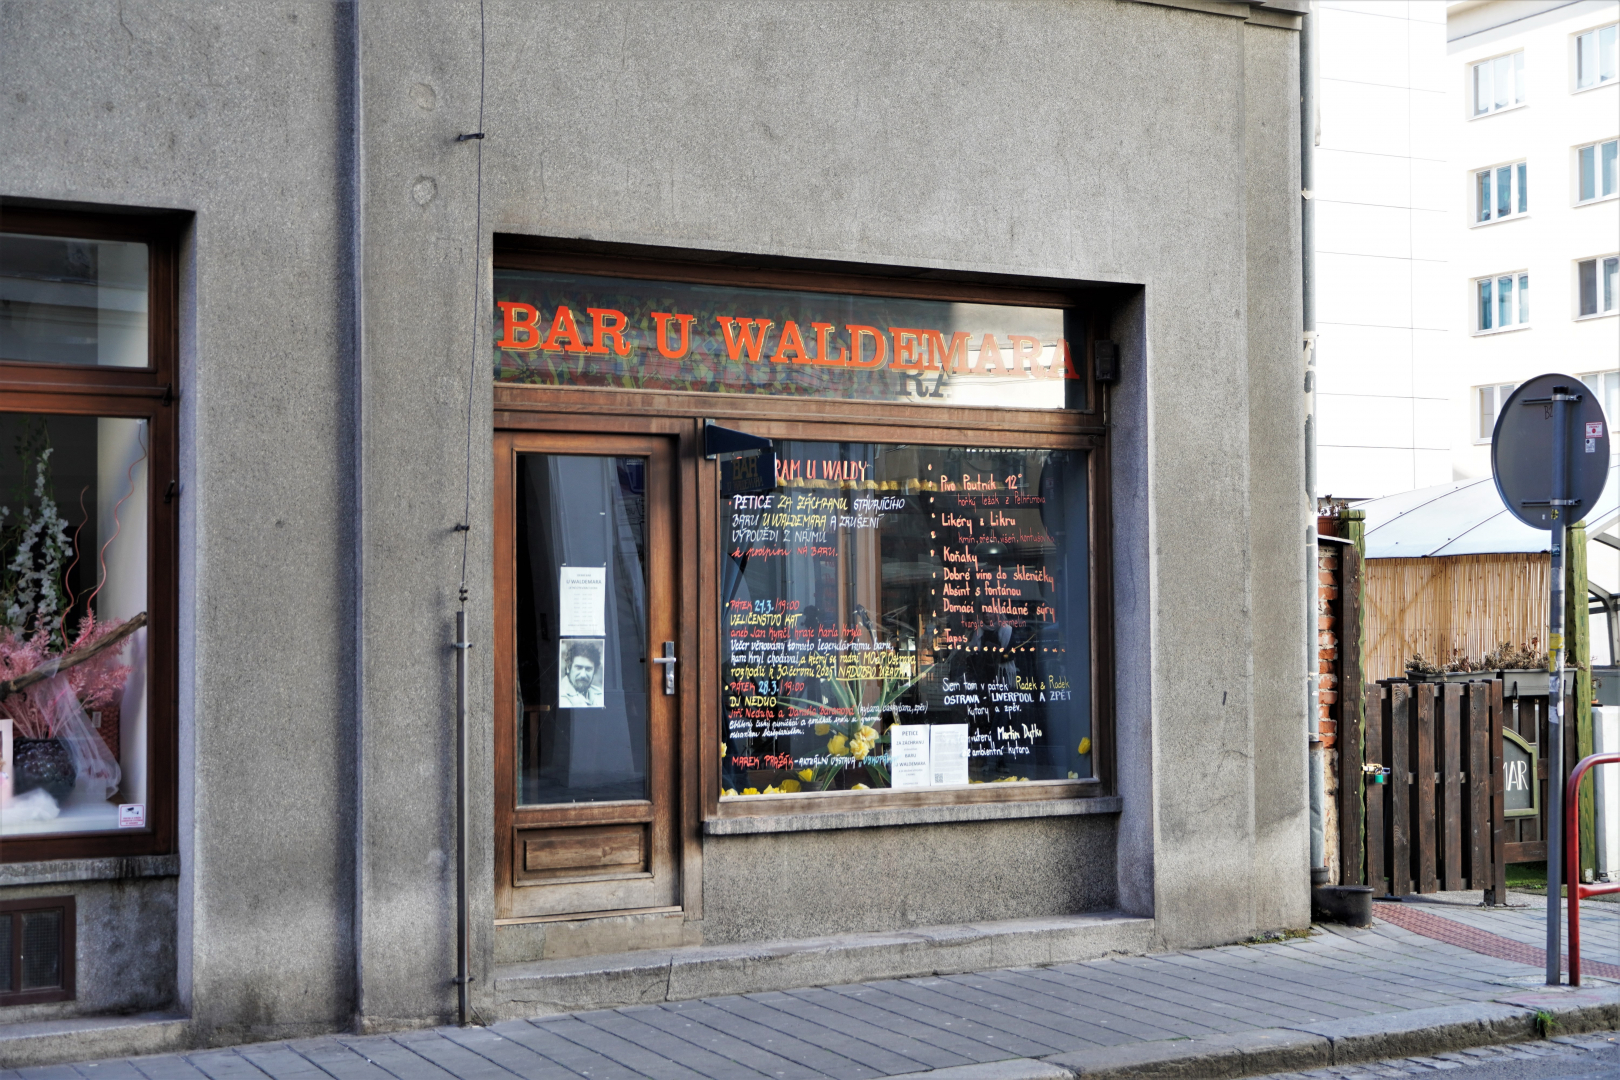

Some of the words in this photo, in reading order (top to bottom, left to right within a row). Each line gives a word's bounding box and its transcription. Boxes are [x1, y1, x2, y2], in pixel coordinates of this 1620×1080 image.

[497, 301, 634, 358] BAR
[650, 312, 697, 360] U
[716, 316, 1081, 381] WALDEMARA
[806, 460, 816, 479] U
[823, 460, 867, 482] WALDY
[940, 474, 956, 491] Pivo
[963, 473, 996, 491] Poutník
[1005, 473, 1022, 490] 12°
[733, 494, 775, 510] PETICE
[778, 495, 793, 509] ZA
[797, 493, 848, 513] ZÁCHRANU
[854, 494, 905, 513] STÁVAJÍCÍHO
[957, 493, 977, 513] hořký
[981, 492, 1000, 505] ležák
[1005, 496, 1009, 504] z
[732, 513, 759, 528] BARU
[771, 513, 827, 531] WALDEMARA
[830, 515, 837, 531] A
[839, 513, 885, 529] ZRUŠENÍ
[941, 512, 972, 535] Likéry
[980, 518, 984, 526] z
[990, 511, 1016, 526] Likru
[732, 528, 778, 543] VÝPOVĚDI
[783, 530, 790, 542] Z
[794, 527, 827, 546] NÁJMU
[797, 546, 807, 557] NA
[943, 545, 978, 571] Koňaky
[944, 567, 970, 581] Dobré
[976, 569, 992, 580] víno
[997, 565, 1007, 580] do
[1013, 564, 1054, 592] skleničky
[943, 581, 970, 596] Absint
[975, 587, 981, 596] s
[984, 580, 1021, 596] fontánou
[730, 598, 752, 613] PÁTEK
[943, 598, 974, 613] Domácí
[982, 597, 1028, 615] nakládané
[1037, 603, 1055, 623] sýry
[730, 612, 781, 626] VELIČENSTVO
[785, 613, 803, 628] KAT
[990, 619, 994, 627] a
[730, 627, 748, 638] aneb
[750, 628, 766, 638] Jan
[794, 627, 814, 643] hraje
[818, 623, 839, 638] Karla
[841, 623, 862, 643] Kryla
[944, 628, 968, 648] Tapas
[730, 639, 750, 651] Večer
[751, 639, 786, 653] věnovaný
[788, 638, 815, 651] tomuto
[817, 638, 871, 655] legendárnímu
[730, 652, 746, 665] kam
[748, 651, 764, 666] Kryl
[808, 652, 829, 667] který
[730, 665, 766, 679] rozhodli
[730, 680, 755, 695] PÁTEK
[942, 677, 960, 692] Sem
[963, 673, 978, 690] tam
[987, 675, 1009, 696] pátek
[1015, 675, 1037, 690] Radek
[1048, 675, 1070, 690] Radek
[729, 696, 742, 707] DJ
[745, 695, 777, 707] NEDUO
[944, 694, 980, 705] OSTRAVA
[991, 692, 1034, 703] LIVERPOOL
[1039, 692, 1046, 702] A
[1049, 690, 1071, 701] ZPĚT
[728, 708, 743, 718] Jiří
[778, 709, 784, 718] a
[787, 704, 816, 717] Daniela
[967, 705, 990, 723] kytary
[997, 725, 1020, 741] Martin
[1021, 723, 1043, 745] Dytko
[972, 741, 1004, 757] ambientní
[1007, 740, 1030, 759] kytara
[732, 755, 759, 770] MAREK
[764, 752, 794, 770] PRAŽÁK
